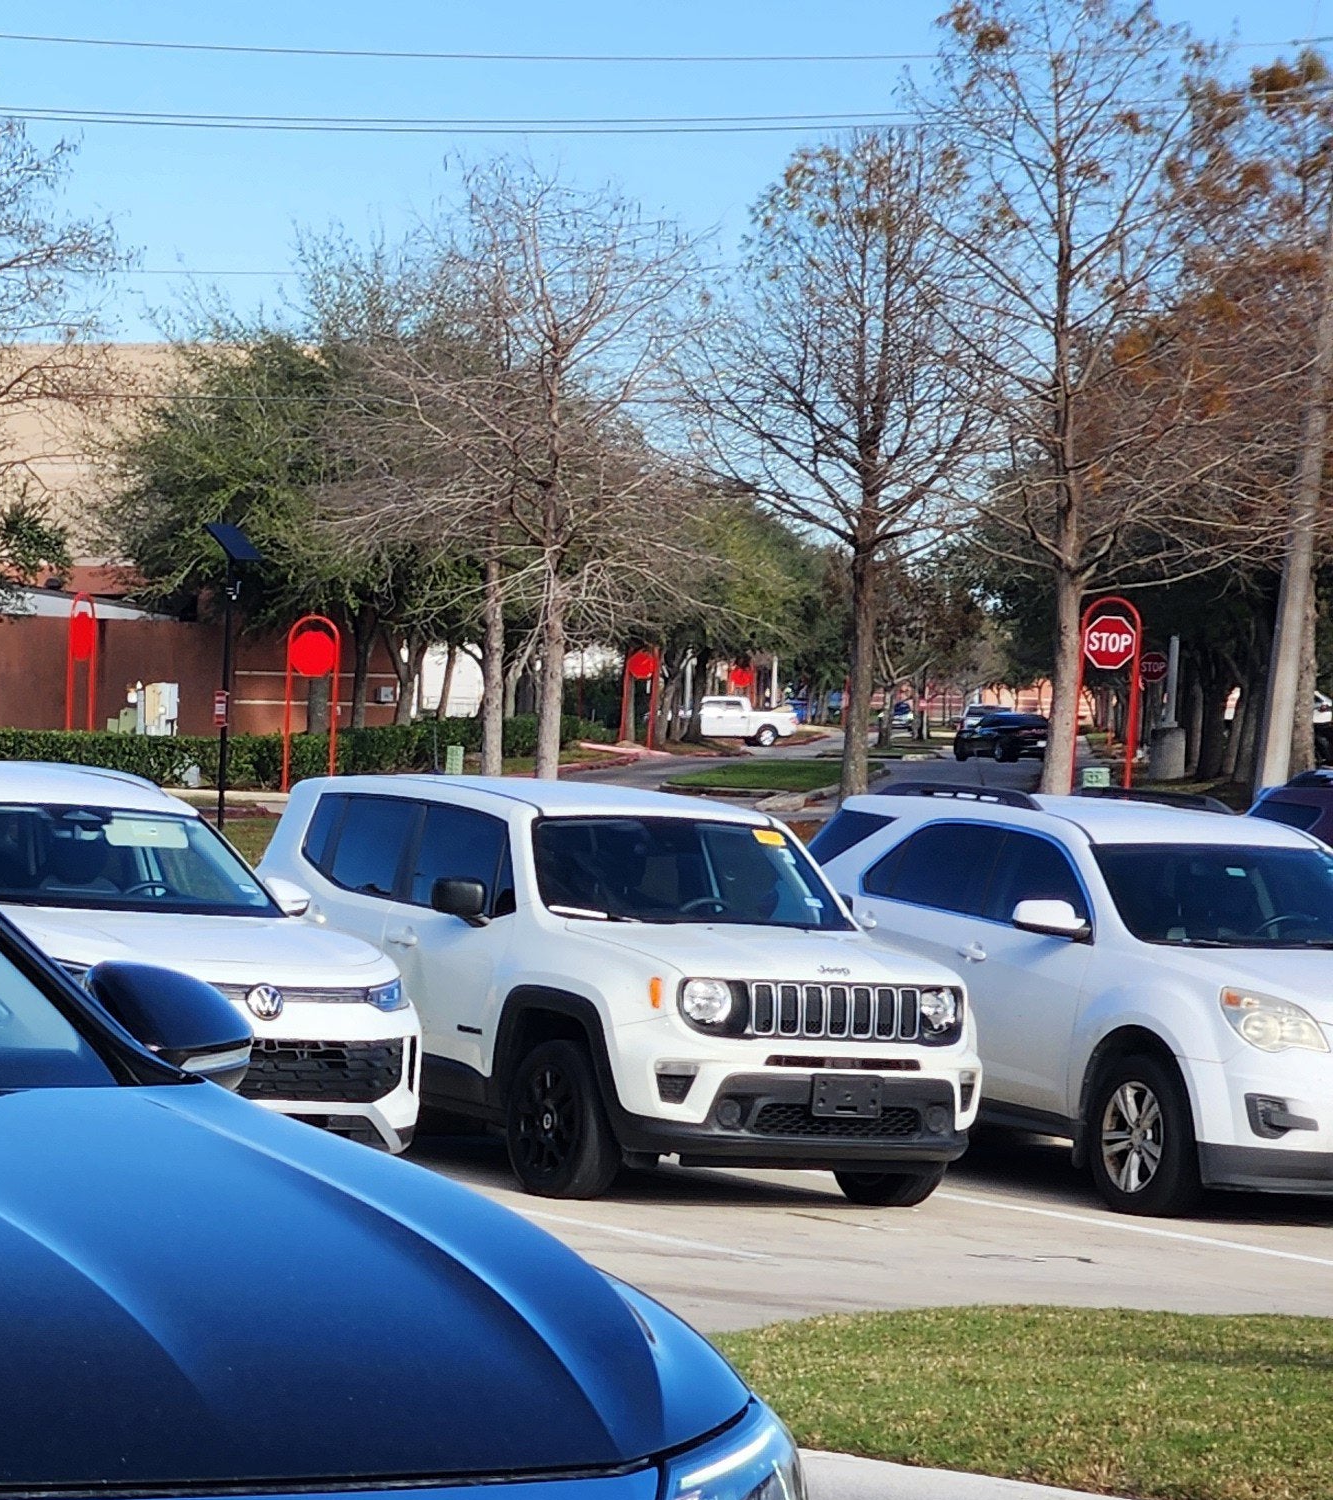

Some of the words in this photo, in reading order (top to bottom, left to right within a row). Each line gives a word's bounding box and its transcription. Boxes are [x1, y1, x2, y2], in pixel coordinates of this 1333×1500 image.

[1088, 631, 1132, 652] STOP
[1140, 661, 1167, 673] STOP
[247, 985, 283, 1020] VW
